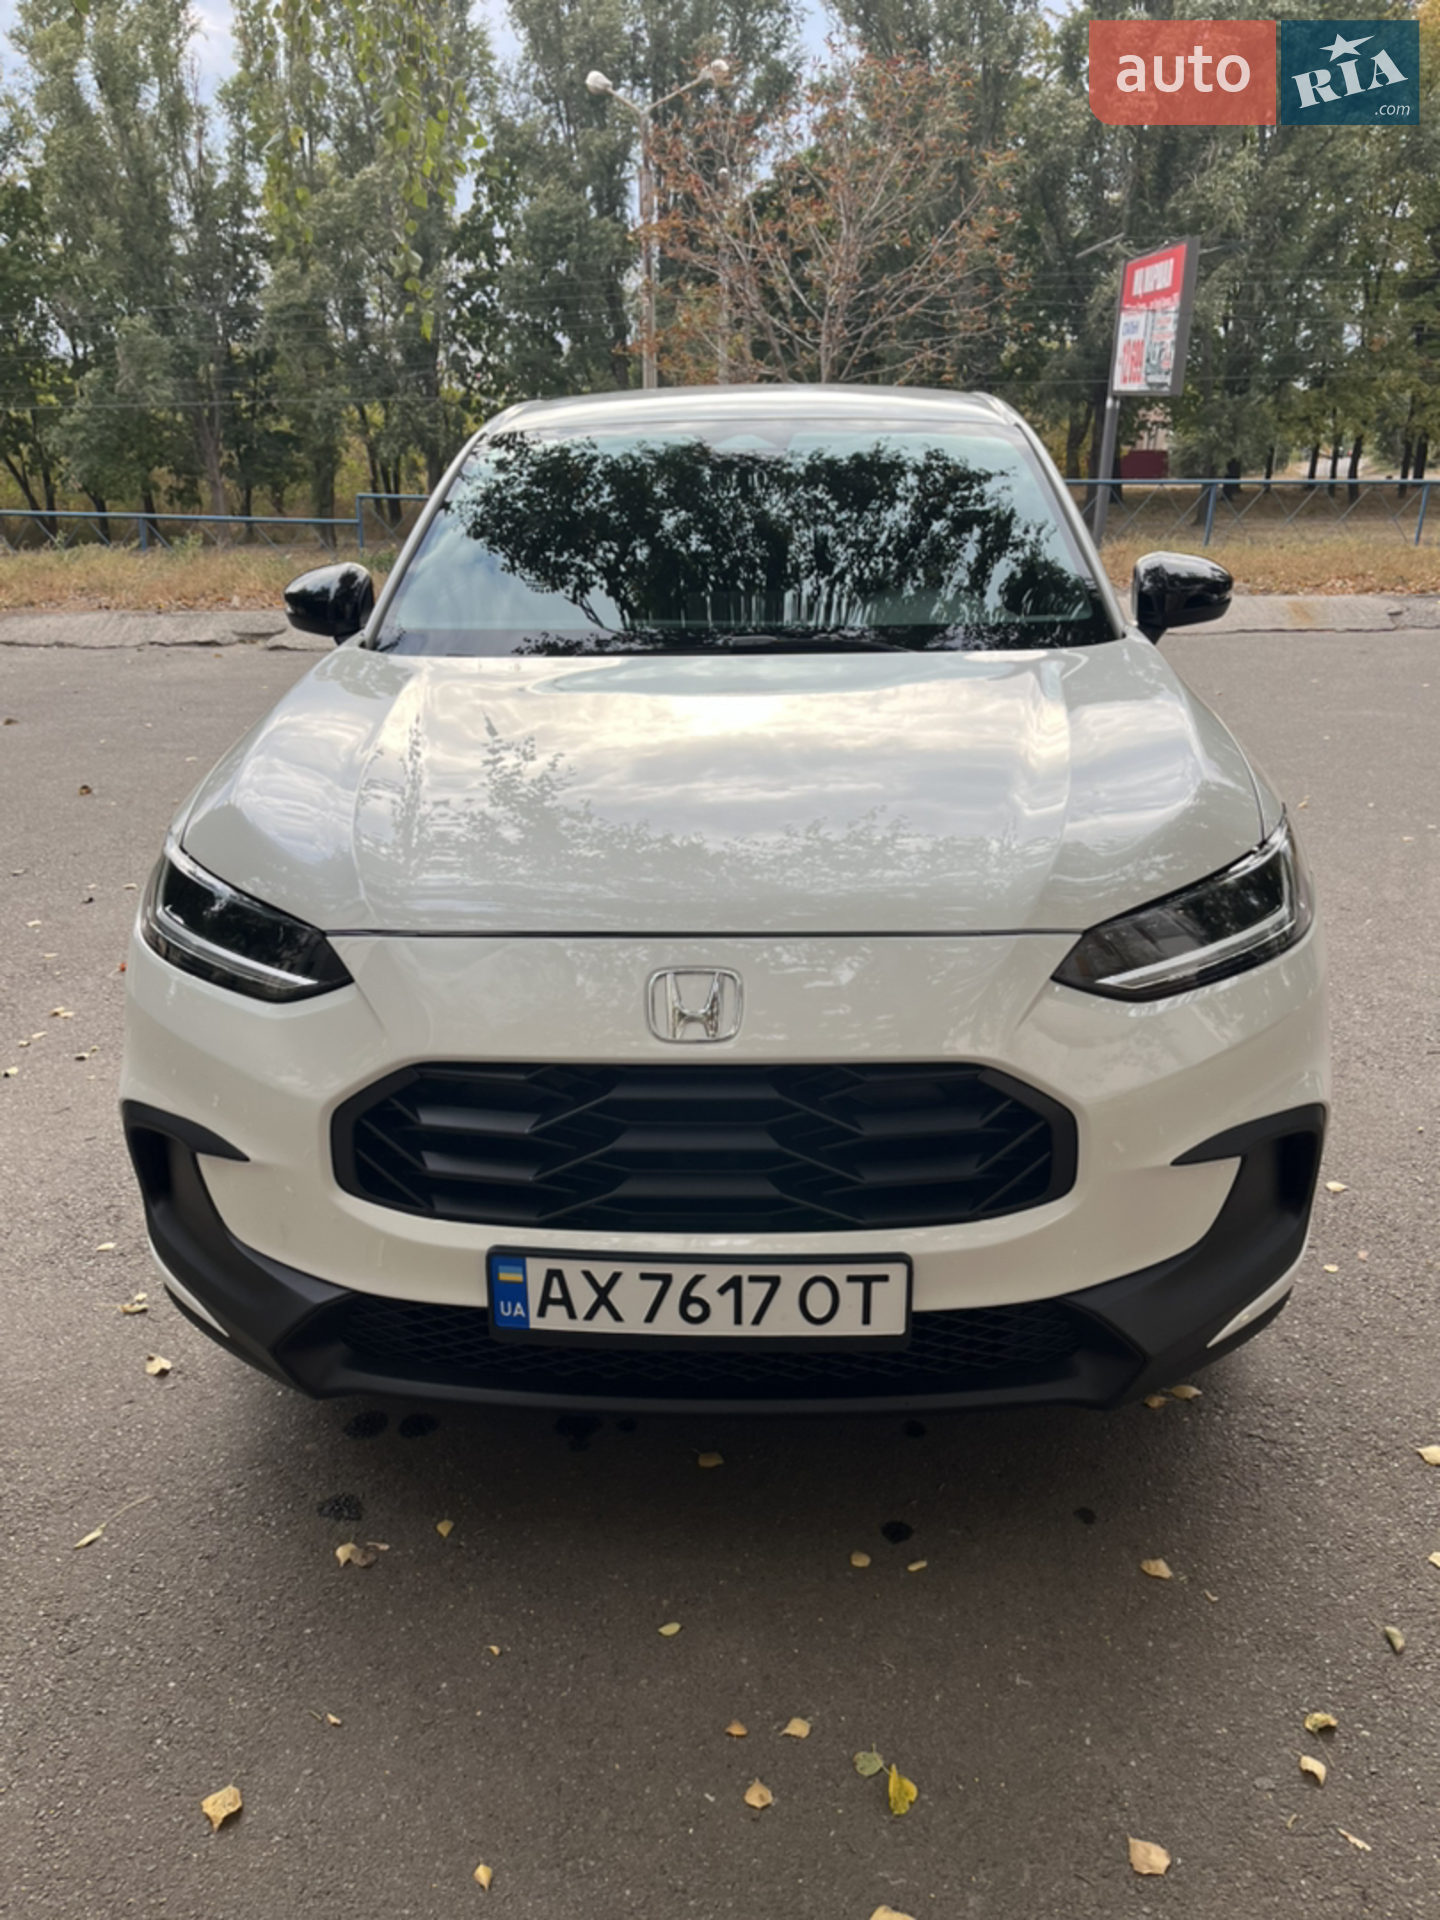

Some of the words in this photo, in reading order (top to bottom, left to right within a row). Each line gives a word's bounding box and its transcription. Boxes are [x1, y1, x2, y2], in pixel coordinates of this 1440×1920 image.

[499, 1300, 527, 1318] UA
[536, 1267, 625, 1323] AX
[638, 1271, 782, 1327] 7617
[797, 1273, 891, 1327] OT
